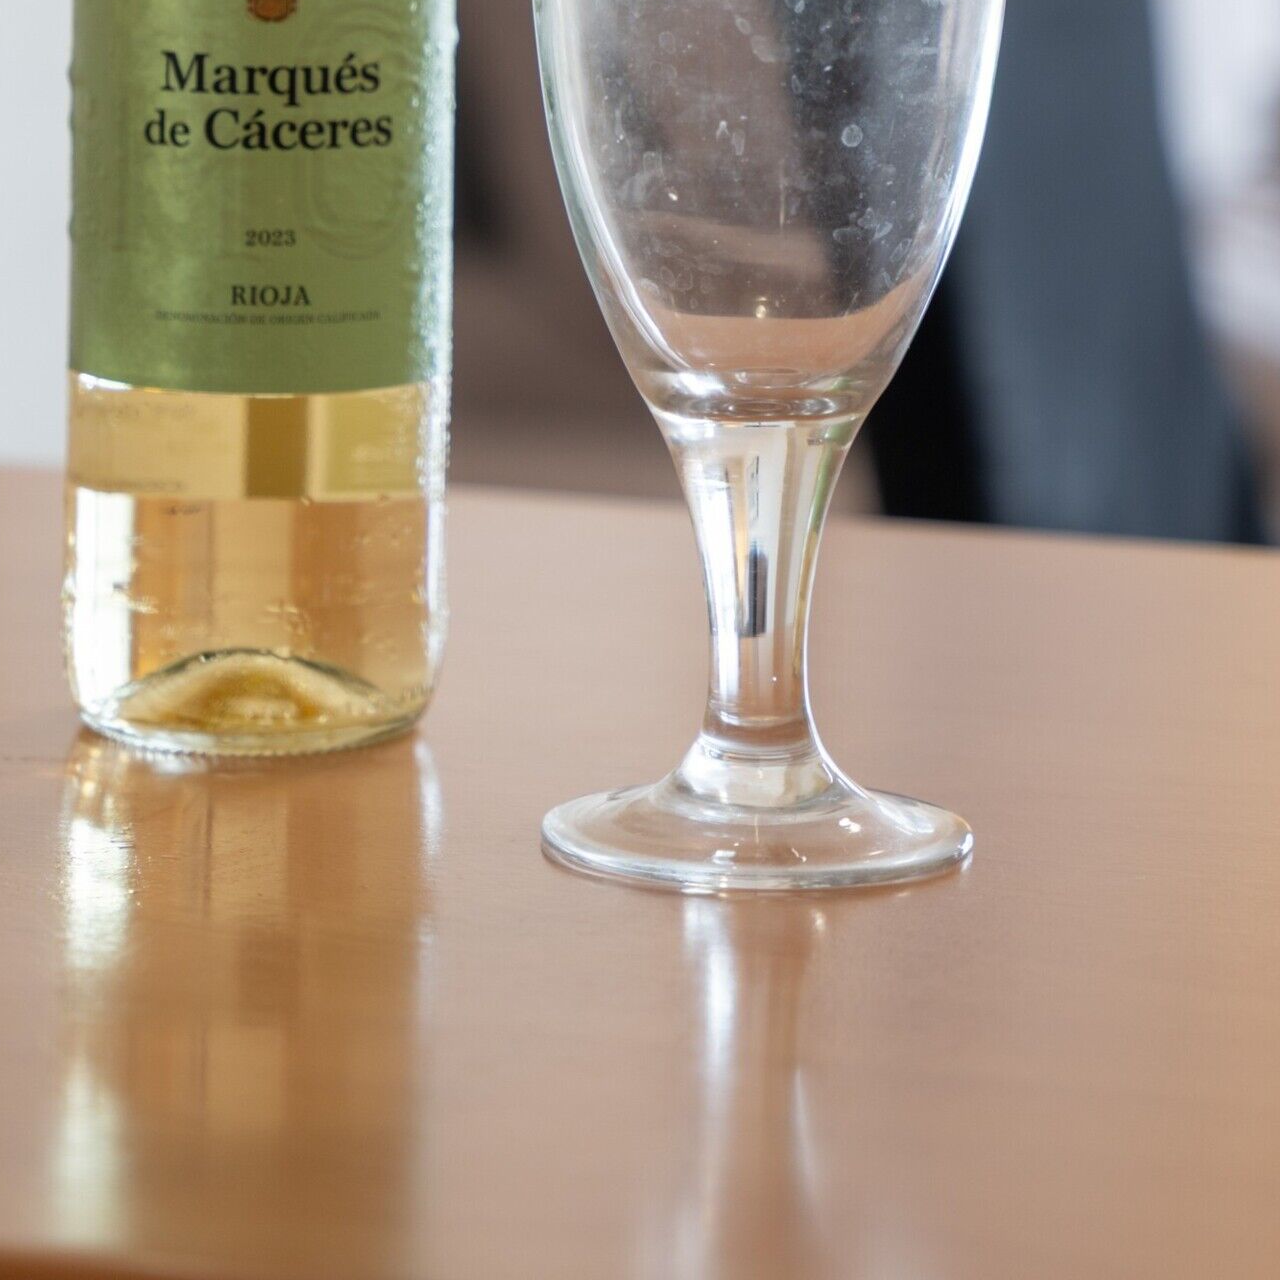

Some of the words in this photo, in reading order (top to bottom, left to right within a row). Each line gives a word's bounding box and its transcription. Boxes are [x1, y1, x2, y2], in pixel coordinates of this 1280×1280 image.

[161, 51, 380, 108] Marqués
[143, 109, 191, 147] de
[203, 108, 392, 150] Cáceres
[245, 229, 296, 247] 2023
[231, 285, 310, 307] RIOJA
